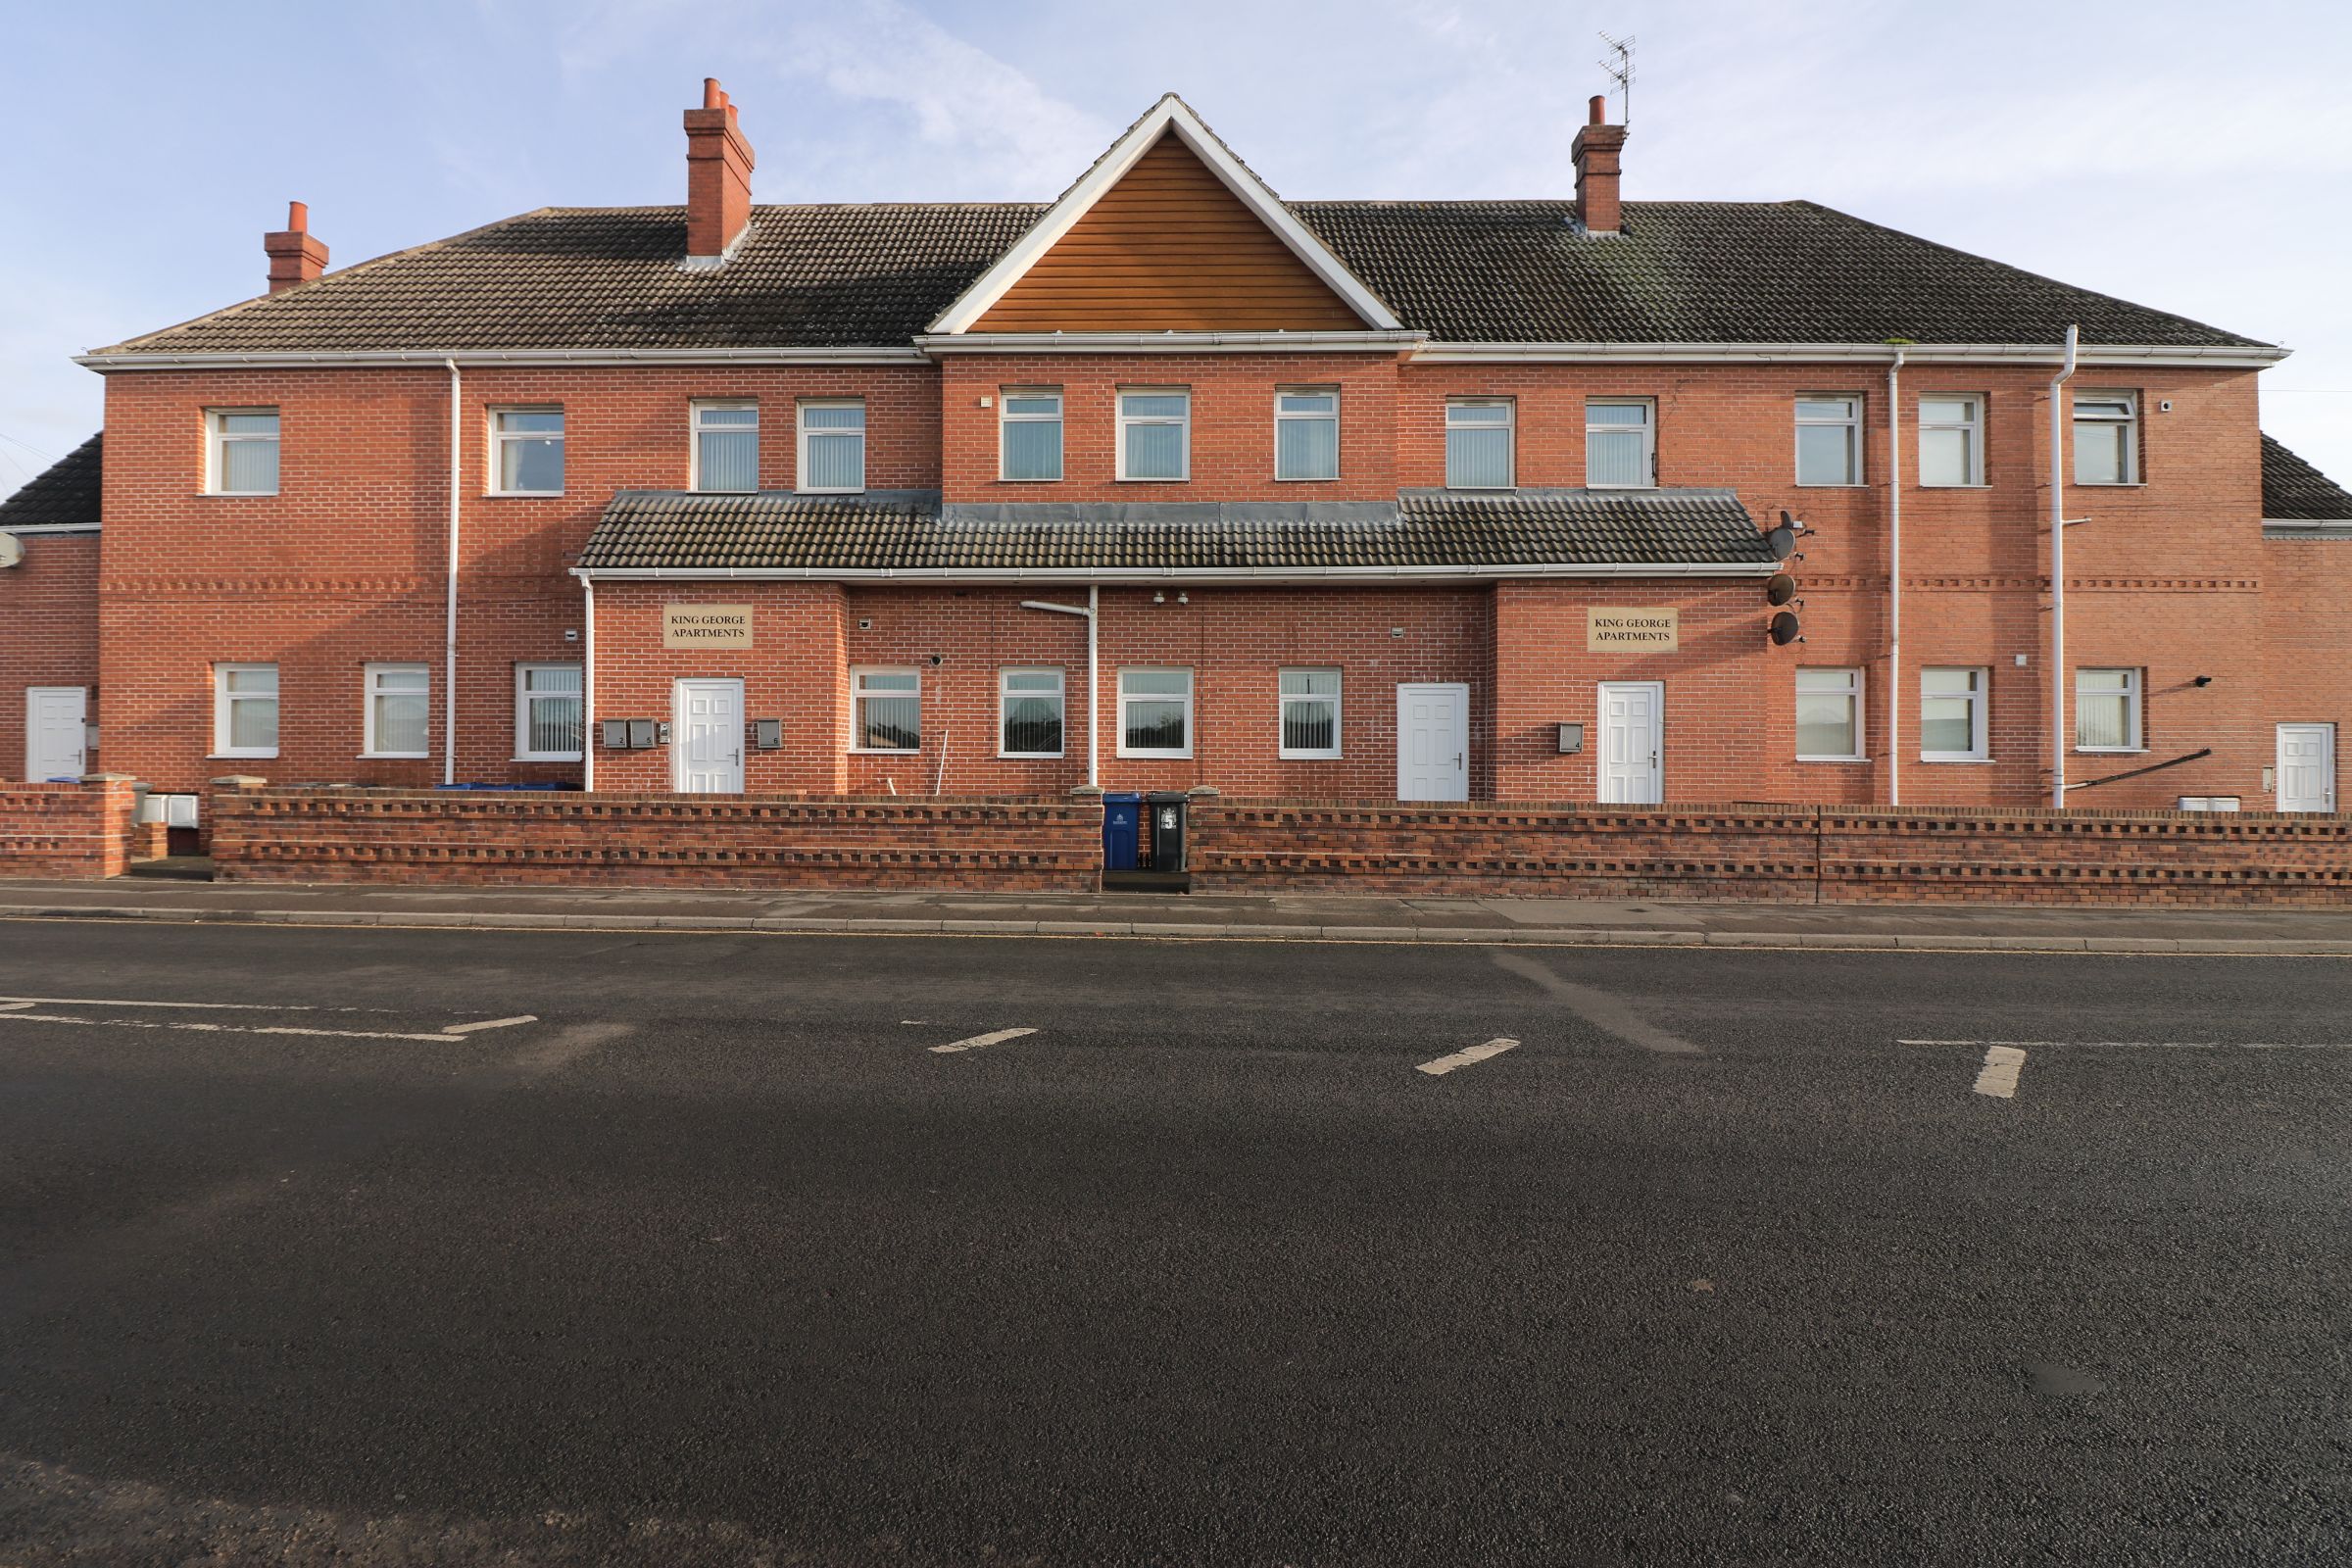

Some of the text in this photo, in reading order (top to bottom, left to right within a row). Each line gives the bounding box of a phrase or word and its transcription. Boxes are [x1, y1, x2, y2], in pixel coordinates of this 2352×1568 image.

[671, 615, 745, 624] KING GEORGE
[1595, 618, 1671, 627] KING GEORGE
[672, 628, 745, 637] APARTMENTS
[1165, 814, 1173, 829] 5
